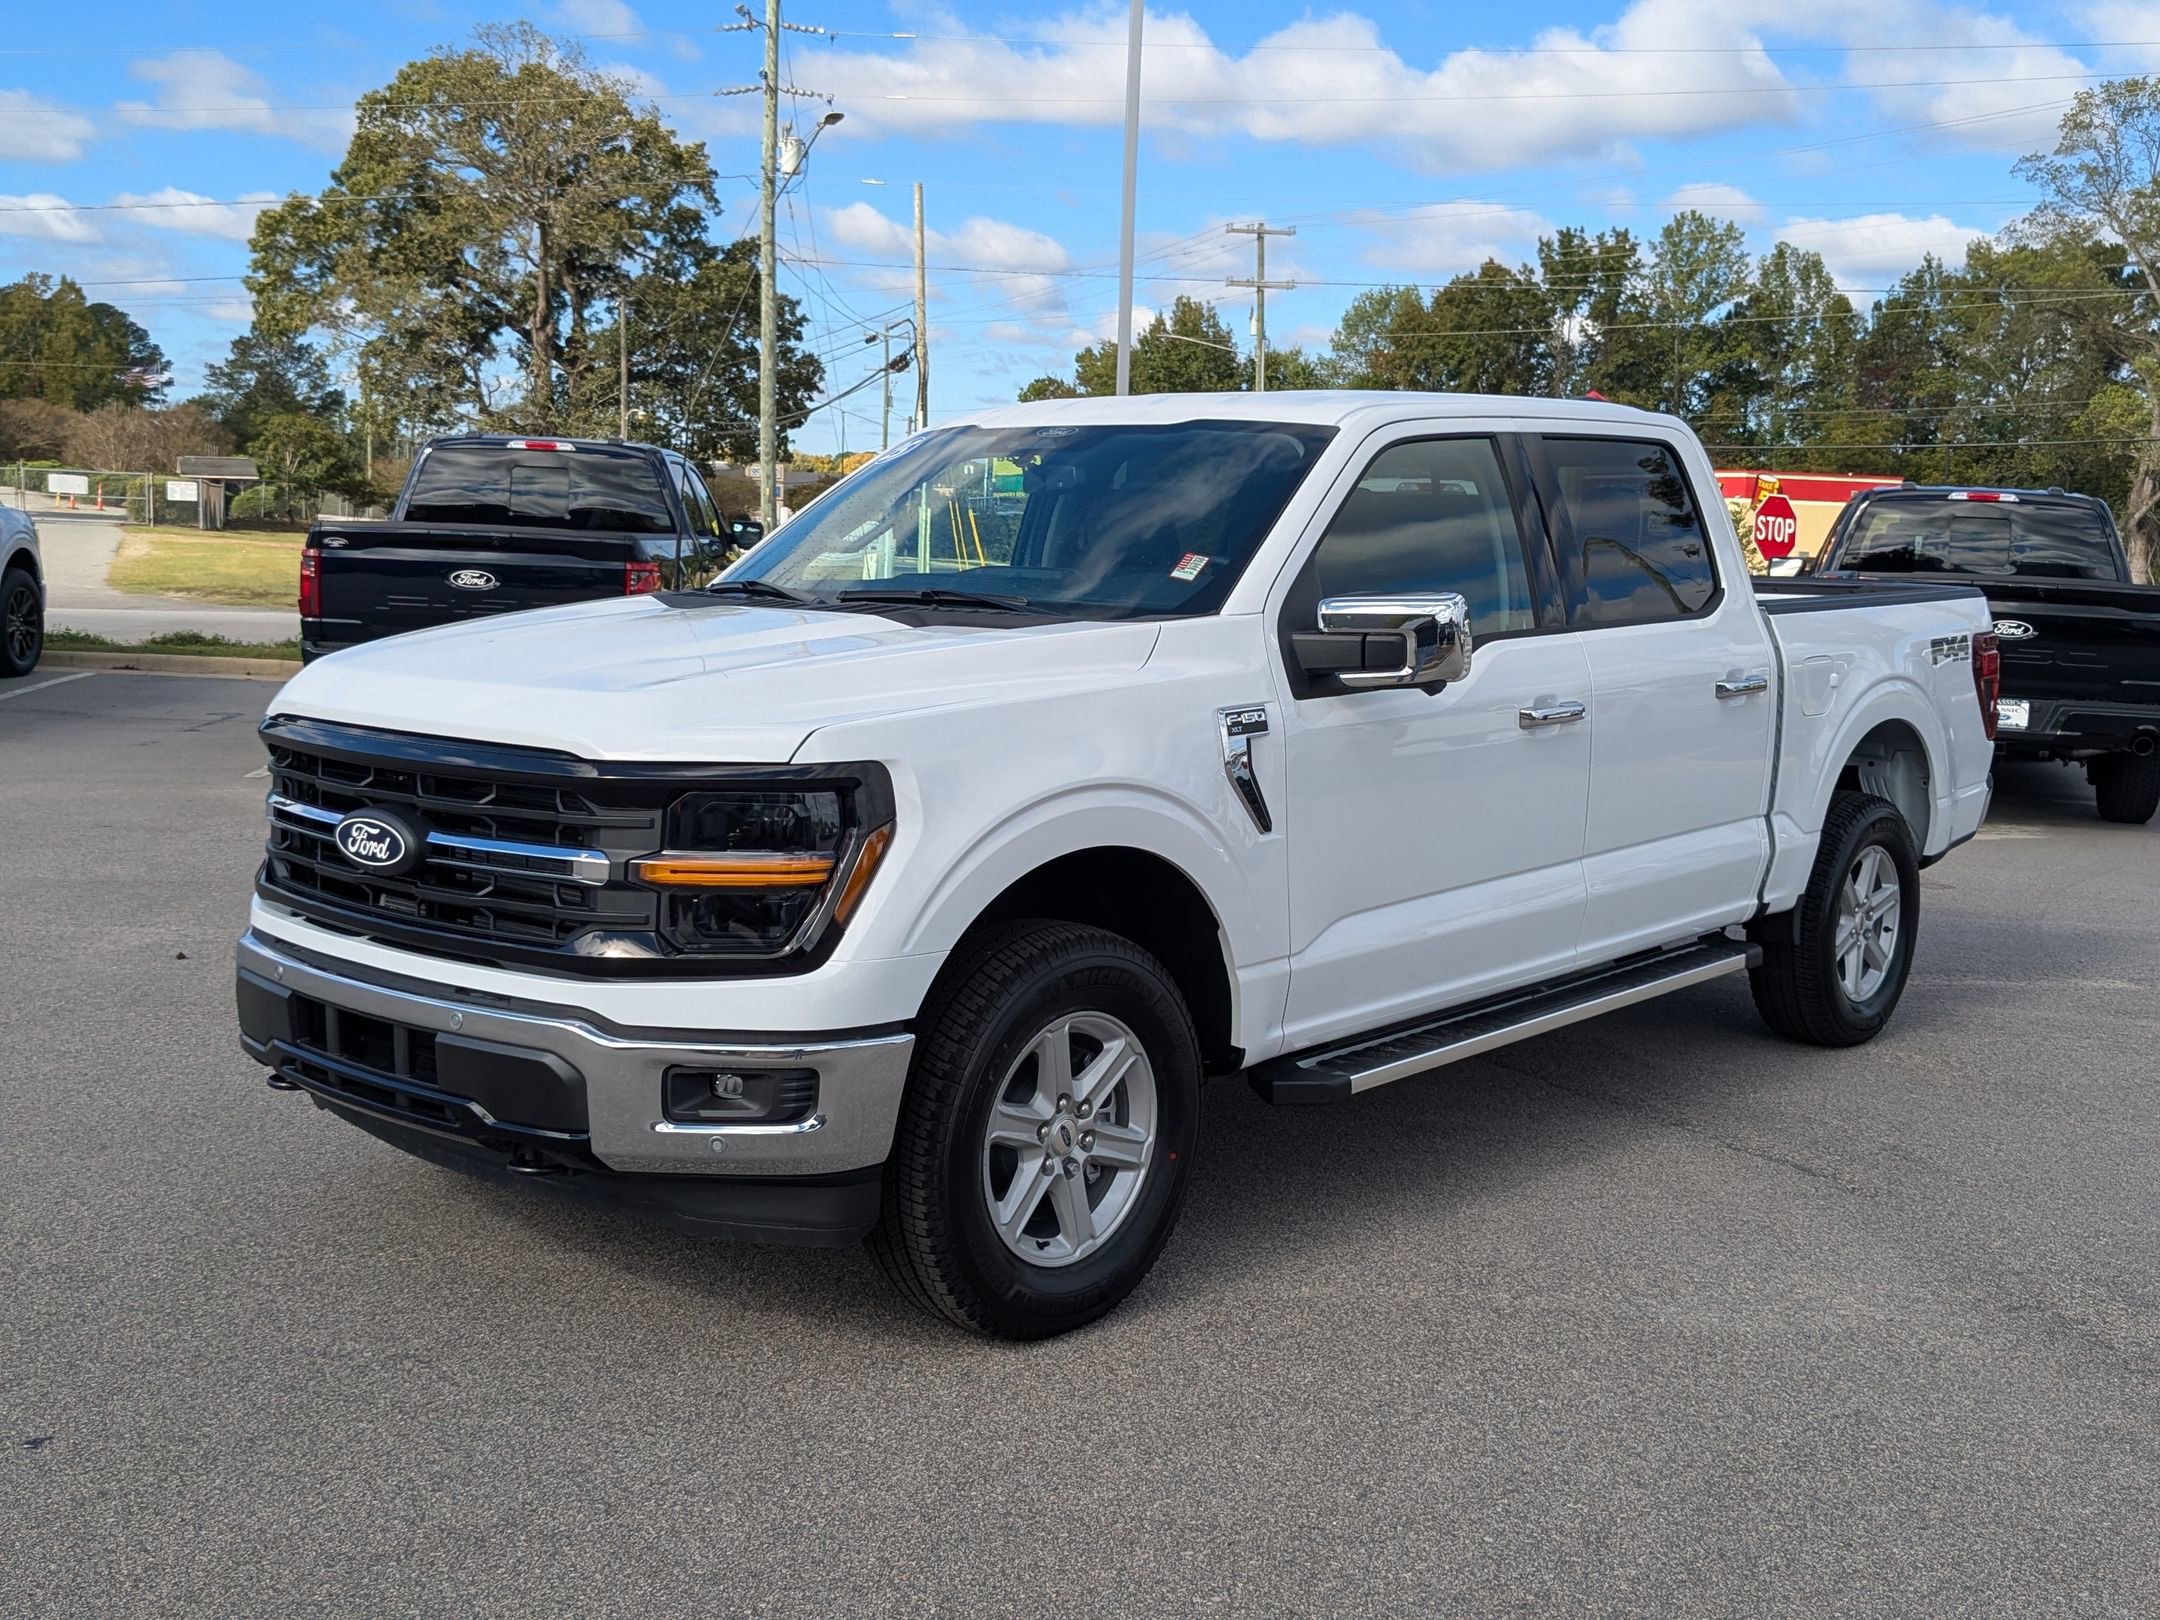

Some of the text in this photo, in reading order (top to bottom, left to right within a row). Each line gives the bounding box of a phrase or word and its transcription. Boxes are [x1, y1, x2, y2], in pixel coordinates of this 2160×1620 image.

[1758, 480, 1774, 490] TAKE
[1756, 515, 1795, 543] STOP
[457, 572, 487, 585] Ford
[1994, 622, 2025, 635] Ford
[1930, 635, 1968, 665] FX4
[1227, 711, 1265, 725] F-150
[348, 823, 391, 859] Ford
